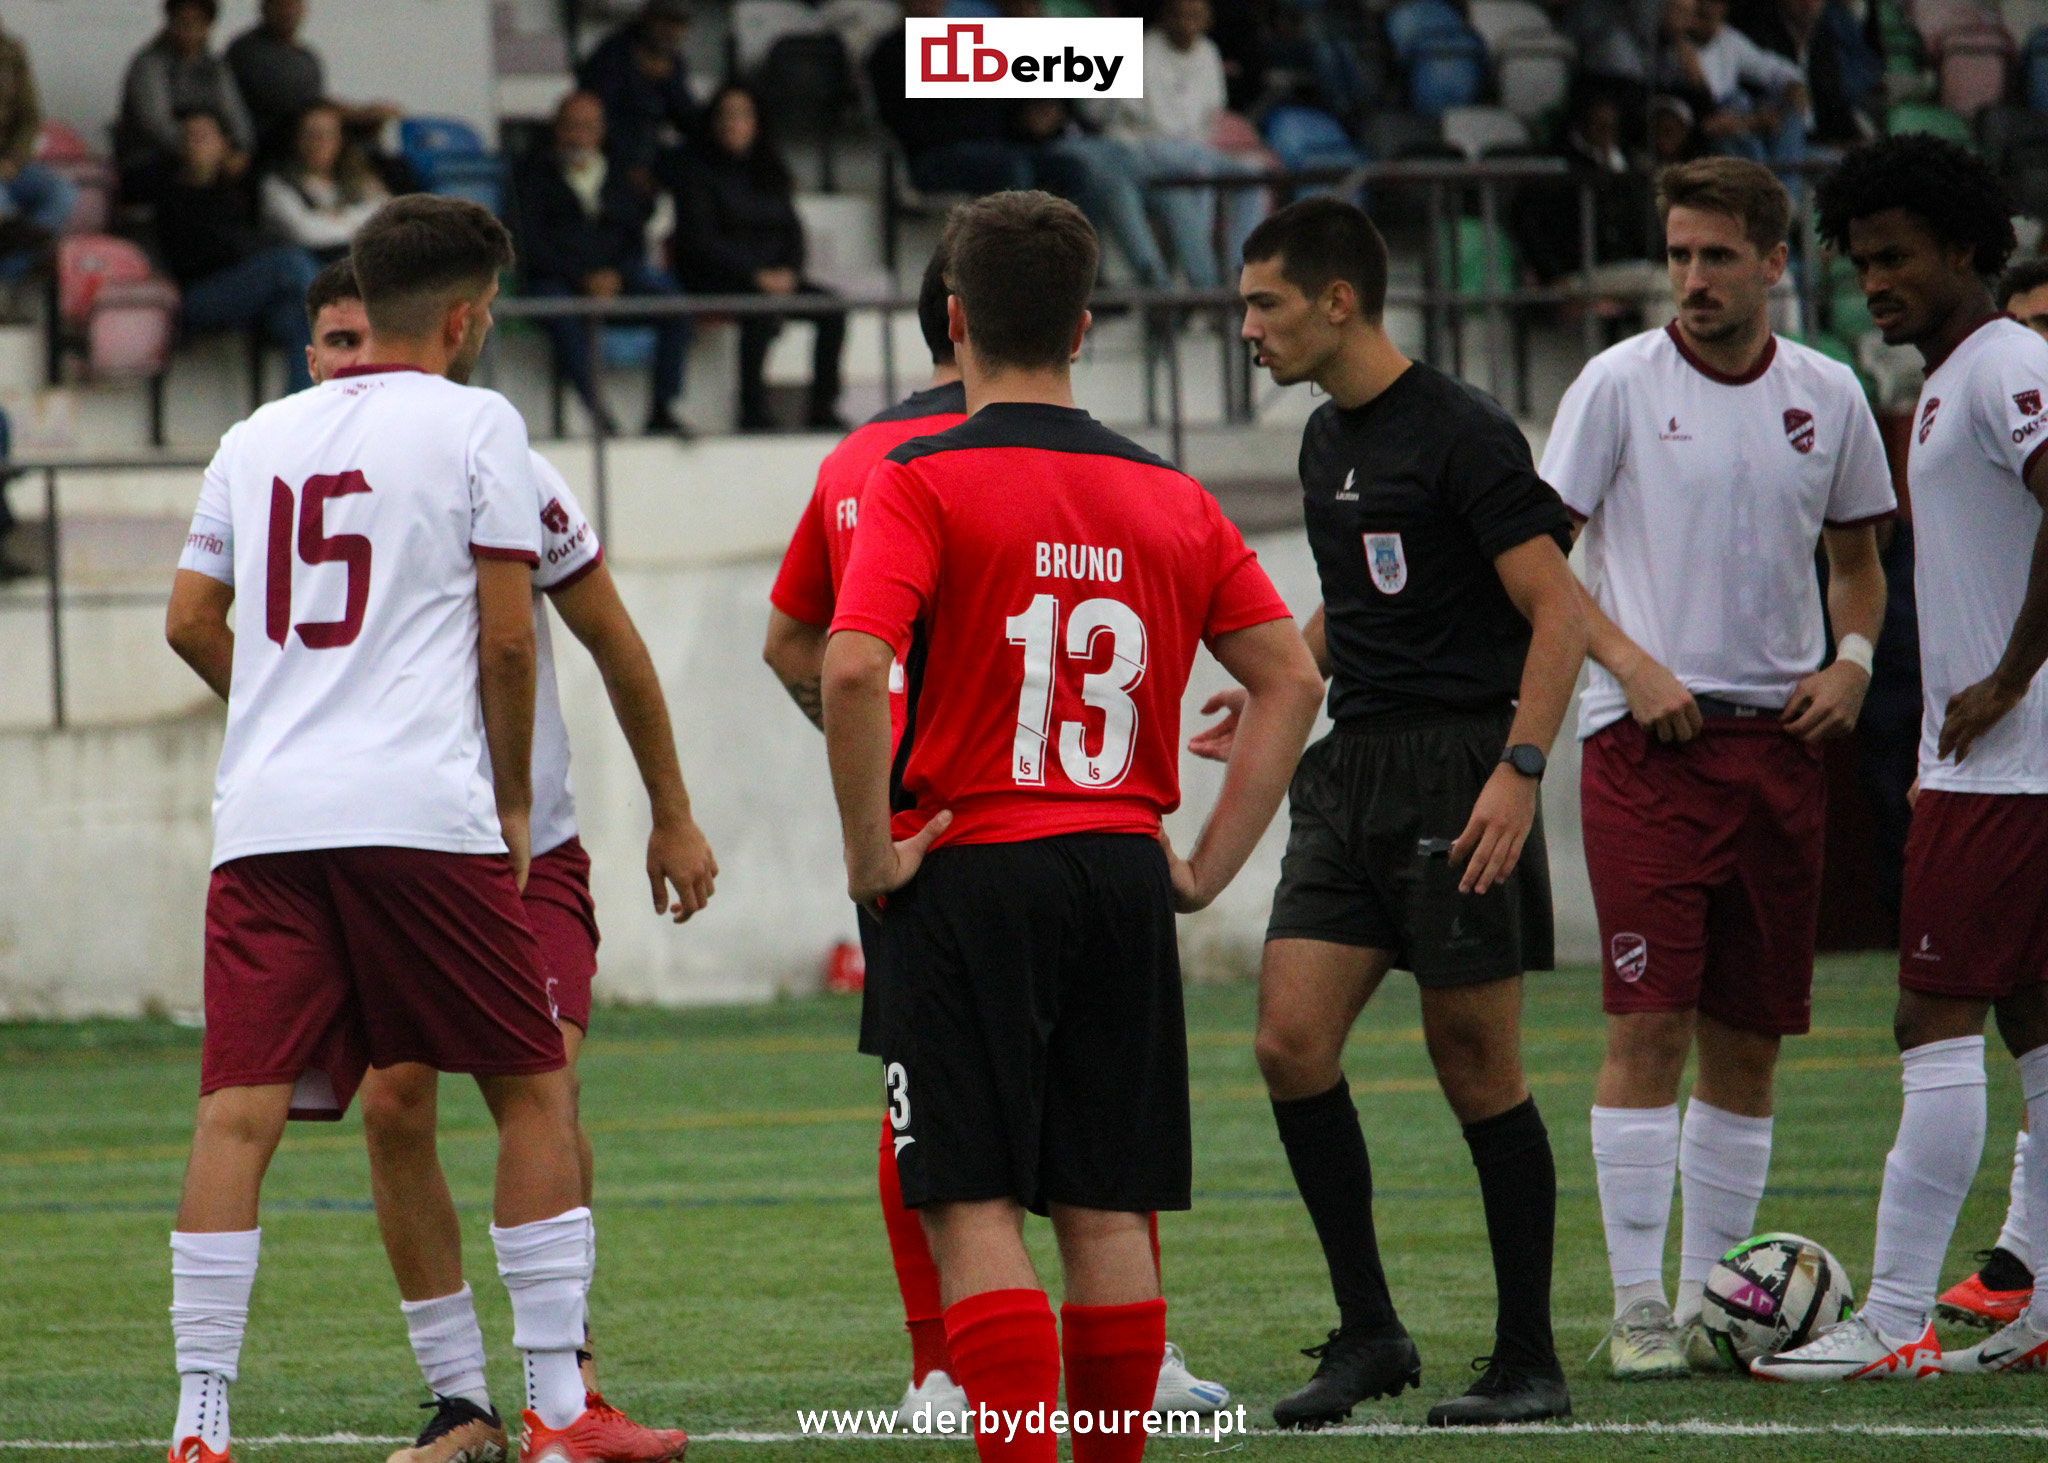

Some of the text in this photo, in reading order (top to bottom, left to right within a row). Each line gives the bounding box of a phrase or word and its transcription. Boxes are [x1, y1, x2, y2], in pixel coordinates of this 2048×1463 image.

[836, 497, 858, 531] FR
[266, 469, 373, 651] 15
[1035, 541, 1123, 582] BRUNO
[1005, 593, 1148, 789] 13
[883, 1062, 912, 1131] 3
